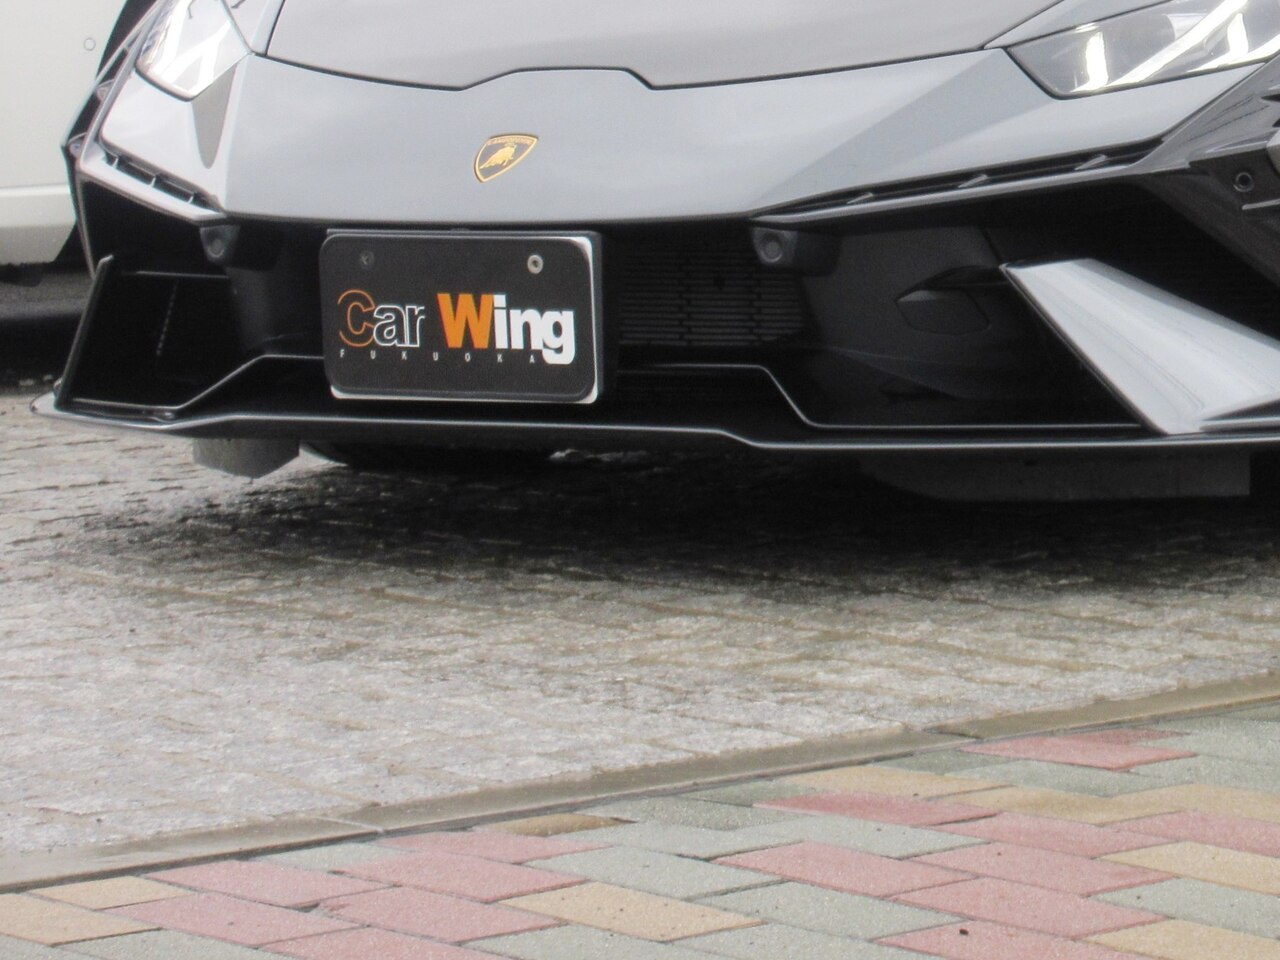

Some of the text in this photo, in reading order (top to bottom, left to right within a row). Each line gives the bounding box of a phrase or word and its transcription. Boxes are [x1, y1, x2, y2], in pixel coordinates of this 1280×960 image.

[337, 289, 576, 365] Car Wing
[339, 349, 537, 365] FUKUOKA
